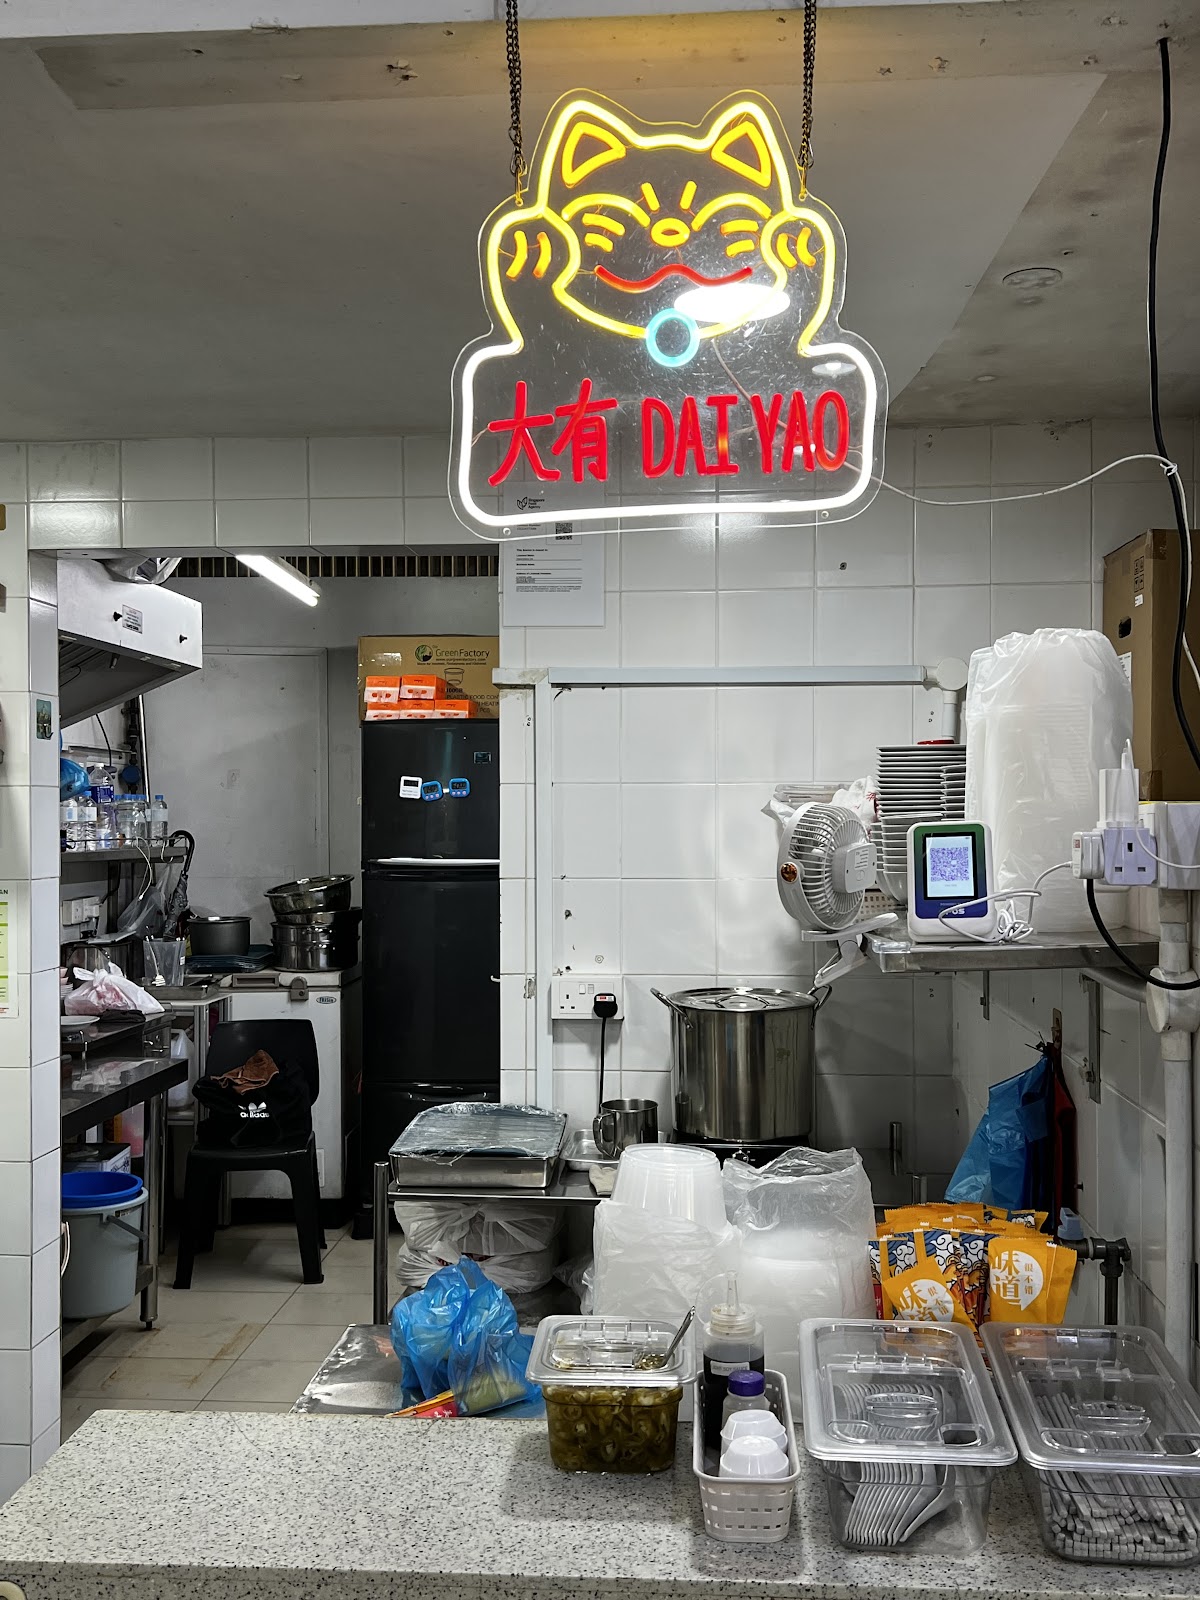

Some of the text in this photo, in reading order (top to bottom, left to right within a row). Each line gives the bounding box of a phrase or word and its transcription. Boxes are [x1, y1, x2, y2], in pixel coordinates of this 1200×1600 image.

[488, 378, 850, 487] 大有 DAI YAO
[436, 649, 490, 658] GreenFactory
[992, 1250, 1021, 1304] 味道
